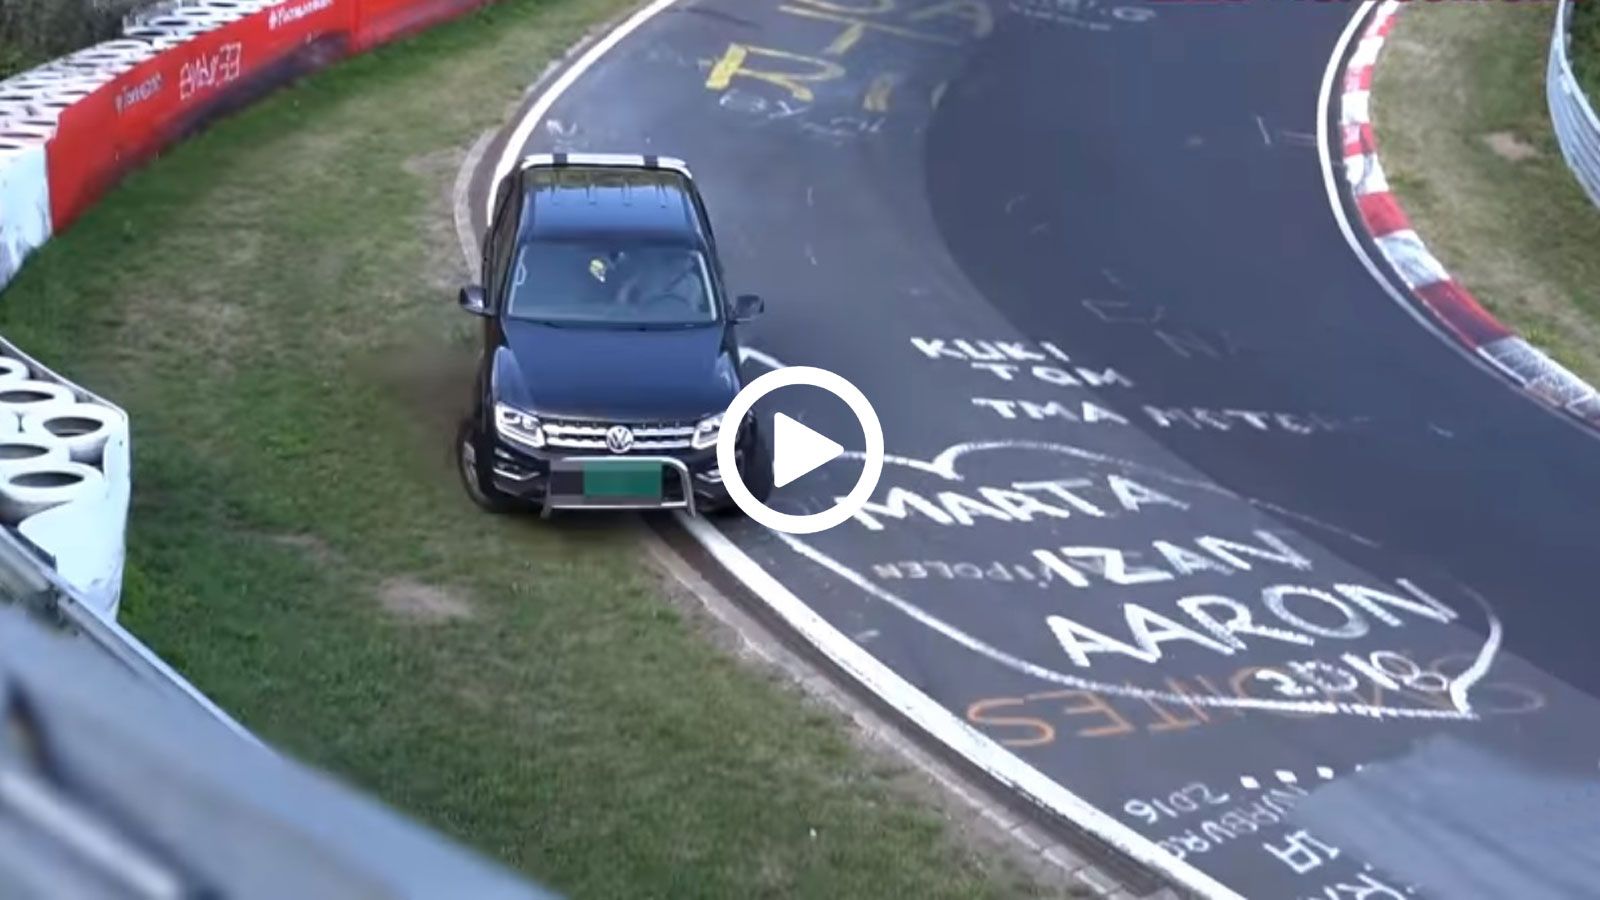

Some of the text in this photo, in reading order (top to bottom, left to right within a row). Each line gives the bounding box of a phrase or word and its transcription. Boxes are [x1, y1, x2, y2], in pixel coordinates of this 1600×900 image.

[910, 336, 1070, 361] KUKI
[971, 398, 1131, 424] TMA
[607, 425, 634, 454] VW
[1032, 529, 1313, 587] IZAN
[1047, 577, 1459, 667] AARON
[1255, 650, 1449, 697] 2018
[1124, 783, 1230, 824] 2016
